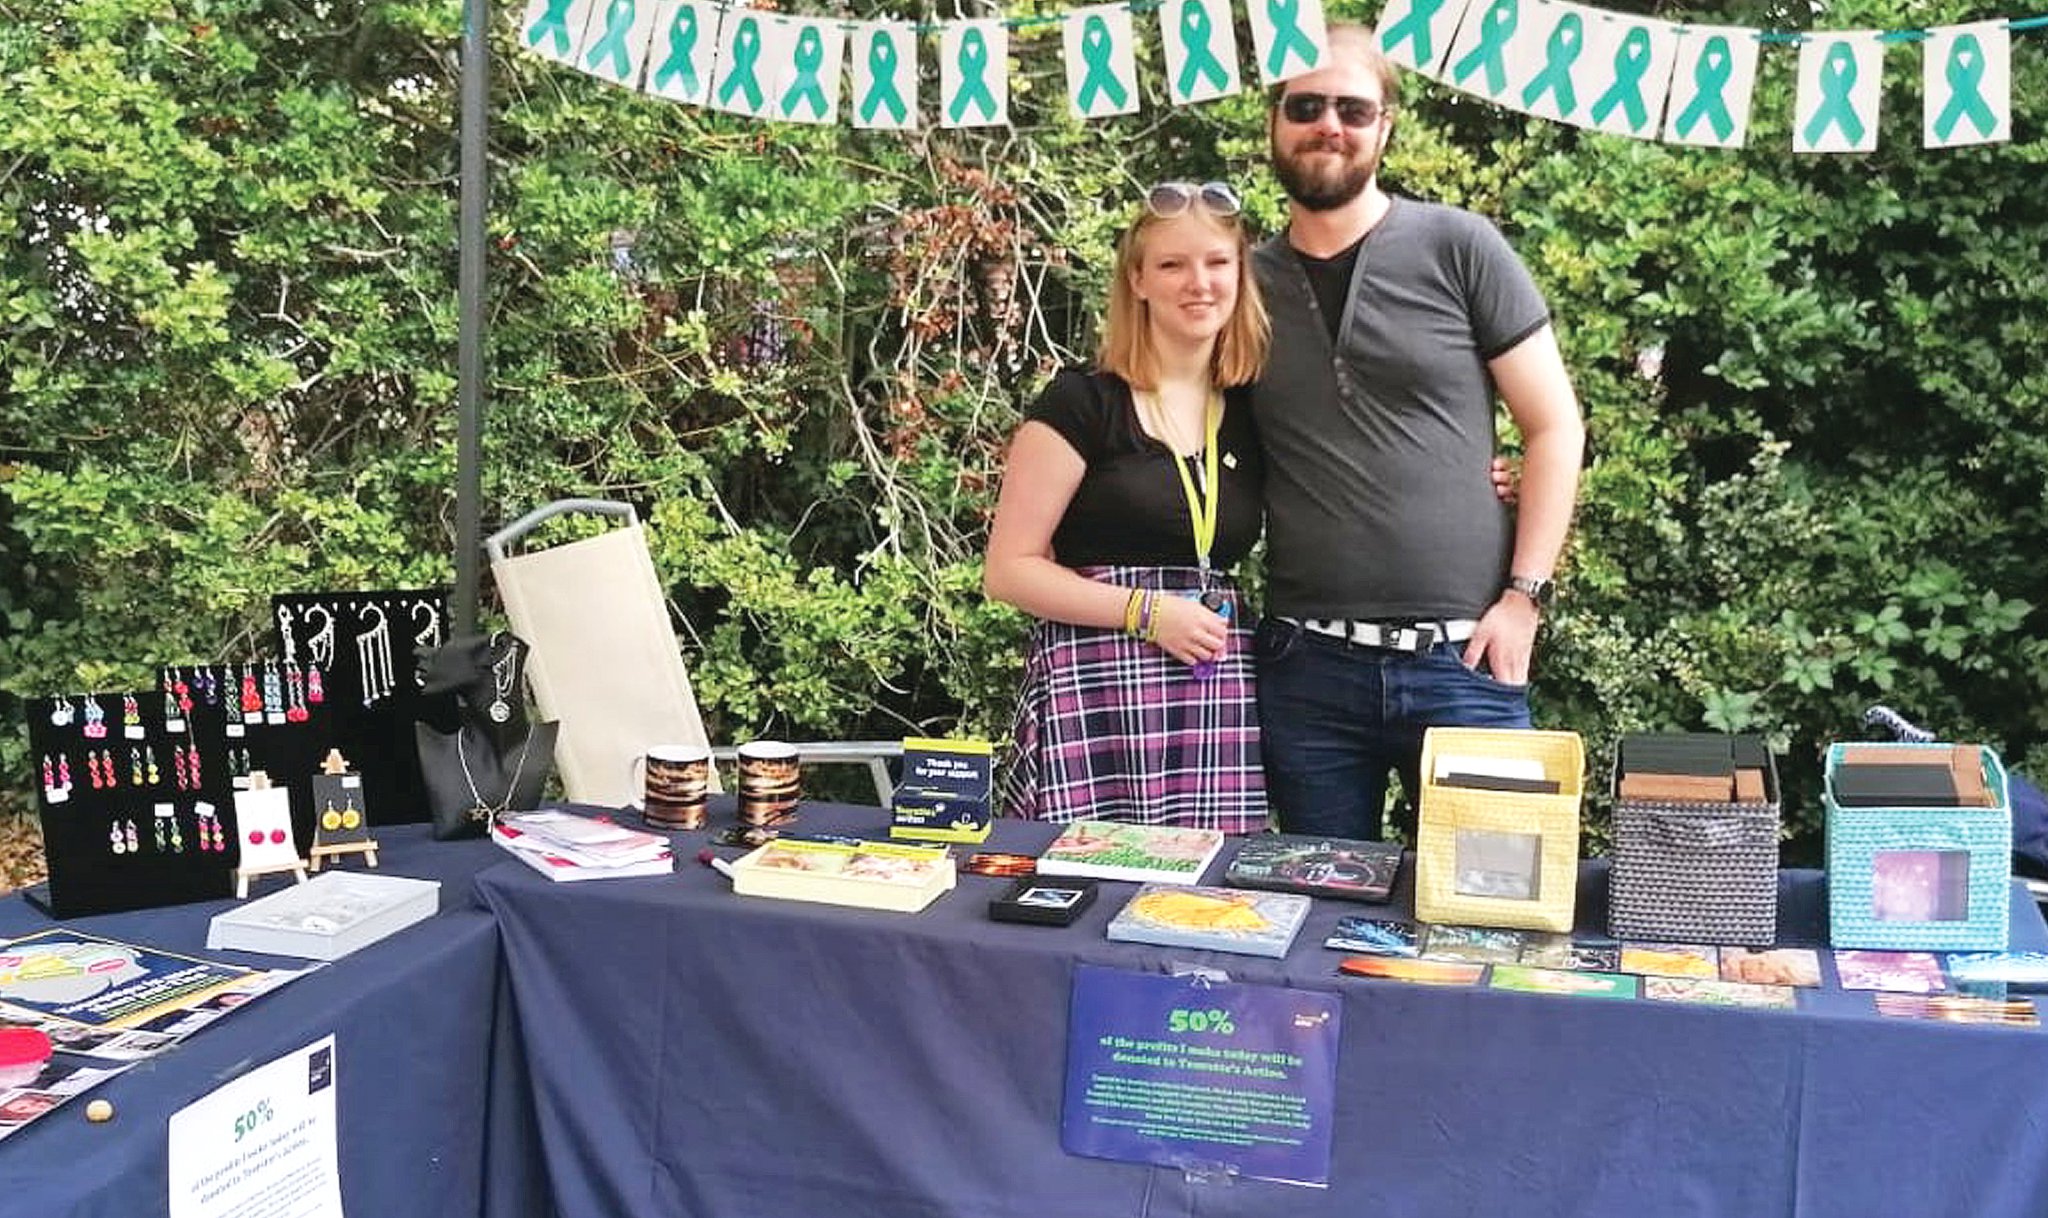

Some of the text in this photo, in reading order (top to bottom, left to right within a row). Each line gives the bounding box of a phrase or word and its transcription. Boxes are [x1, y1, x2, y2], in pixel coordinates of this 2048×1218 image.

[1169, 1008, 1235, 1034] 50%
[1099, 1035, 1114, 1047] of
[1114, 1037, 1135, 1050] the
[234, 1096, 274, 1143] 50%
